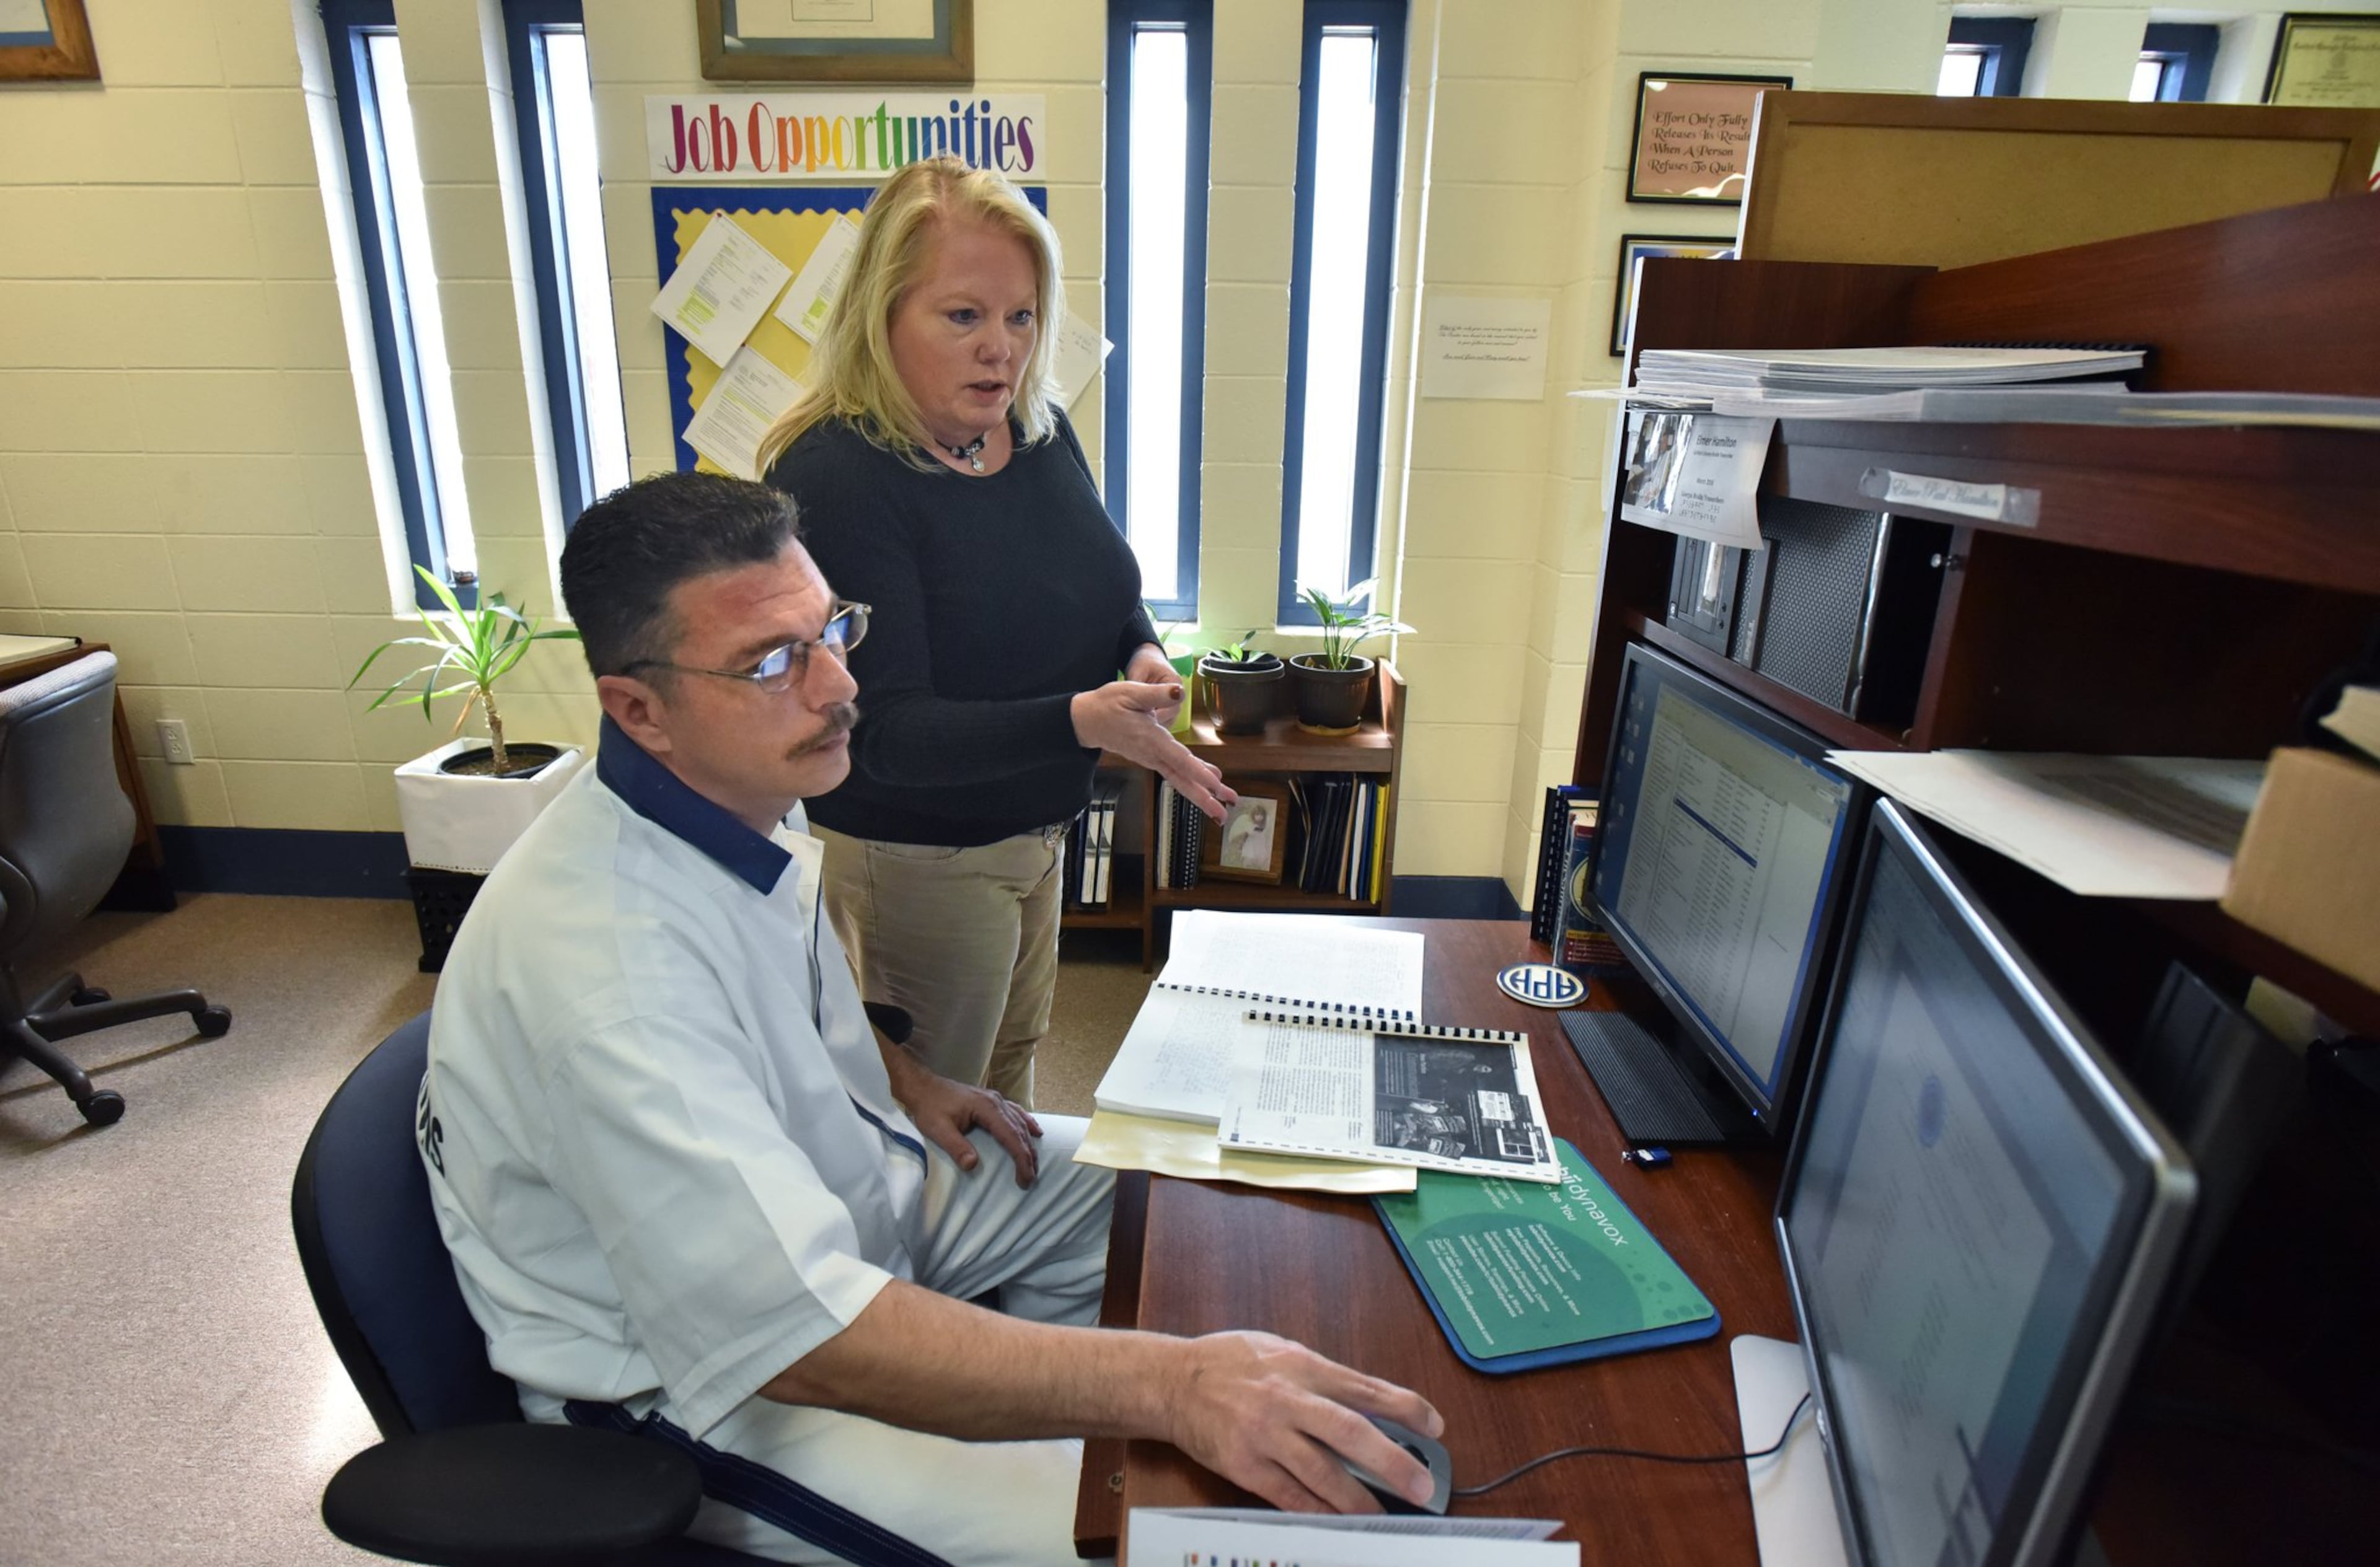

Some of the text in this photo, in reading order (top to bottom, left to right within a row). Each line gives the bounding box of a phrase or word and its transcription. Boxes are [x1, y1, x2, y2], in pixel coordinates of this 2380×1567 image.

[1653, 111, 1748, 129] Effort Only Fully
[664, 100, 1034, 174] Job Opportunities
[1652, 128, 1696, 142] Releases
[1650, 143, 1733, 159] When A Person
[1647, 159, 1688, 174] Refuses
[1691, 160, 1706, 174] To
[1560, 1166, 1628, 1246] bii dynavox
[1560, 1203, 1577, 1221] You
